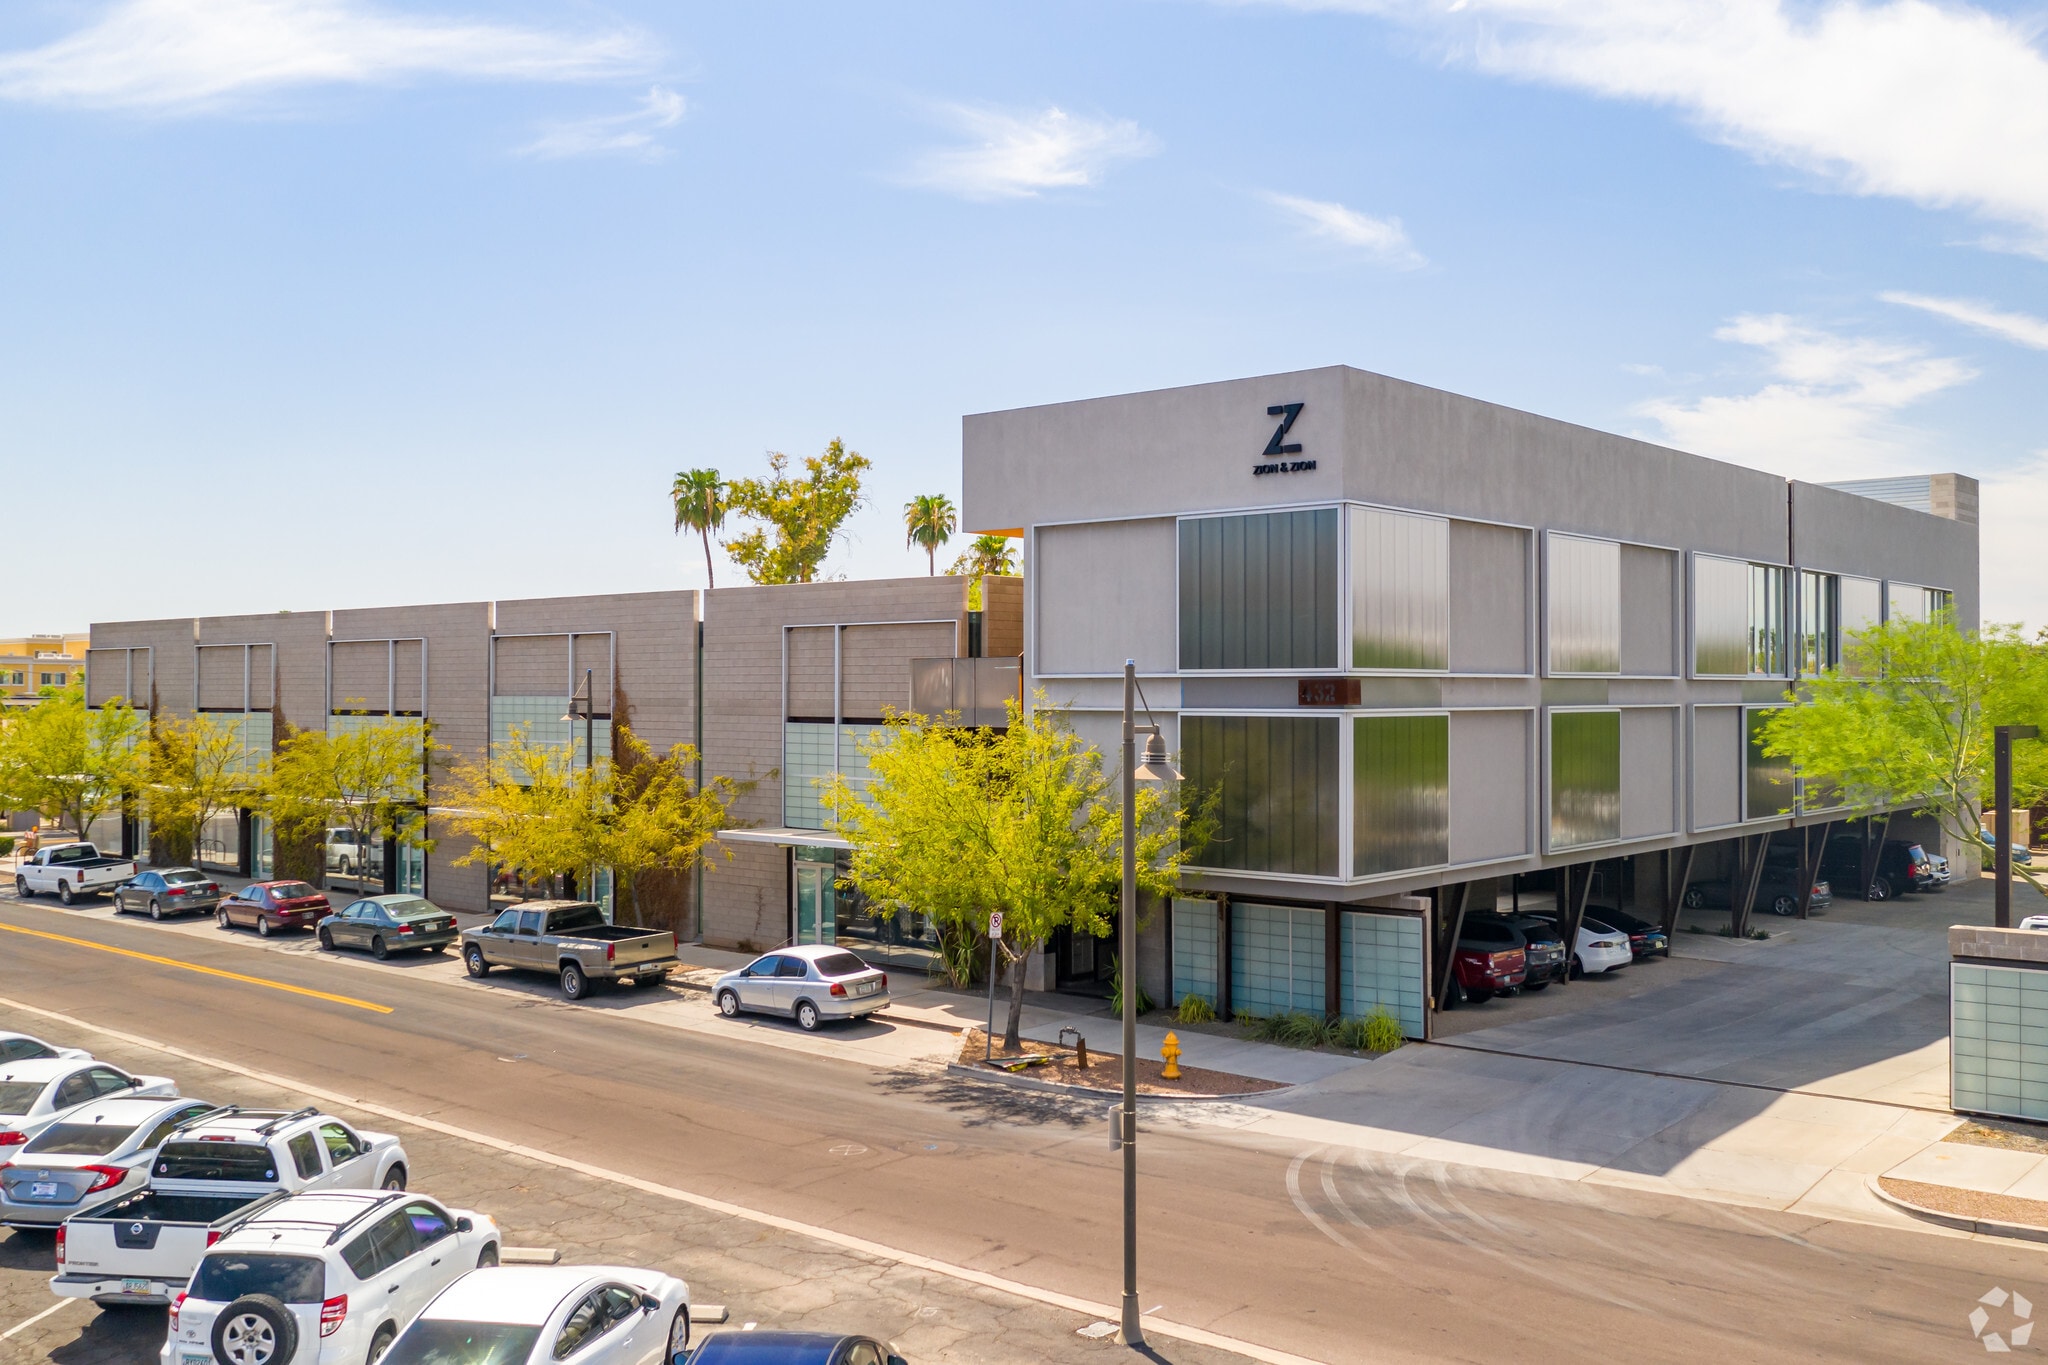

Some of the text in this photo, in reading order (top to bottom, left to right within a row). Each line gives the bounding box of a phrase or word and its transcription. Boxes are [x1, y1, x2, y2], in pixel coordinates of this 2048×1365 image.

[1262, 402, 1305, 455] Z
[1252, 460, 1317, 475] ZION & ZION
[1300, 683, 1336, 702] 432
